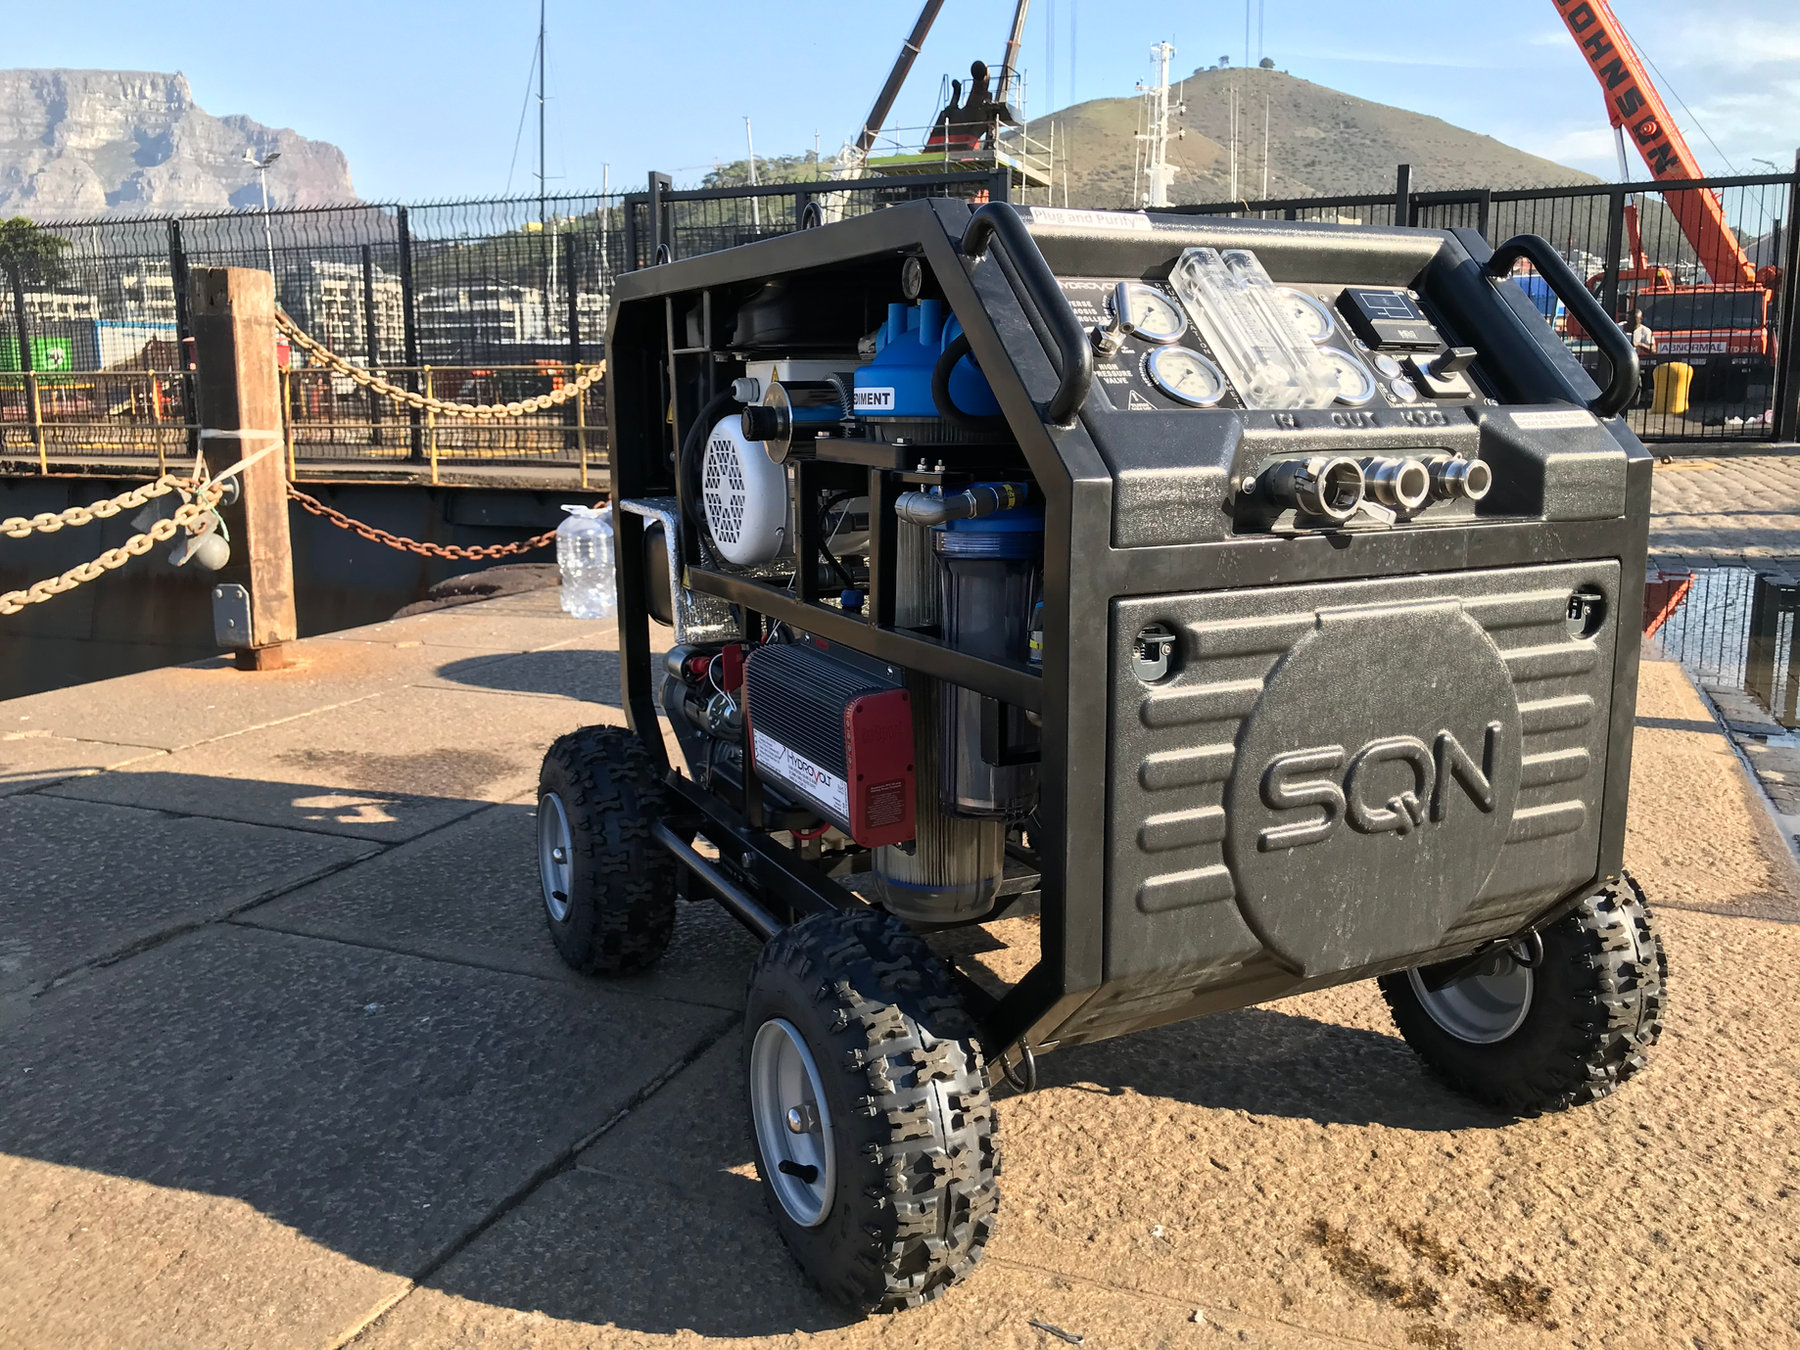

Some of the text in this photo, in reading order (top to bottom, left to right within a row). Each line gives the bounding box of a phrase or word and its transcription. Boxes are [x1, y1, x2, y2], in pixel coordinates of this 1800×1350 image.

[1034, 209, 1064, 224] Plug
[1068, 213, 1093, 223] and
[1661, 343, 1724, 353] ABNORMAL
[854, 392, 890, 405] DIMENT
[1331, 412, 1377, 426] OUT
[787, 748, 832, 787] HYDROVOLT
[1257, 720, 1502, 852] SQN
